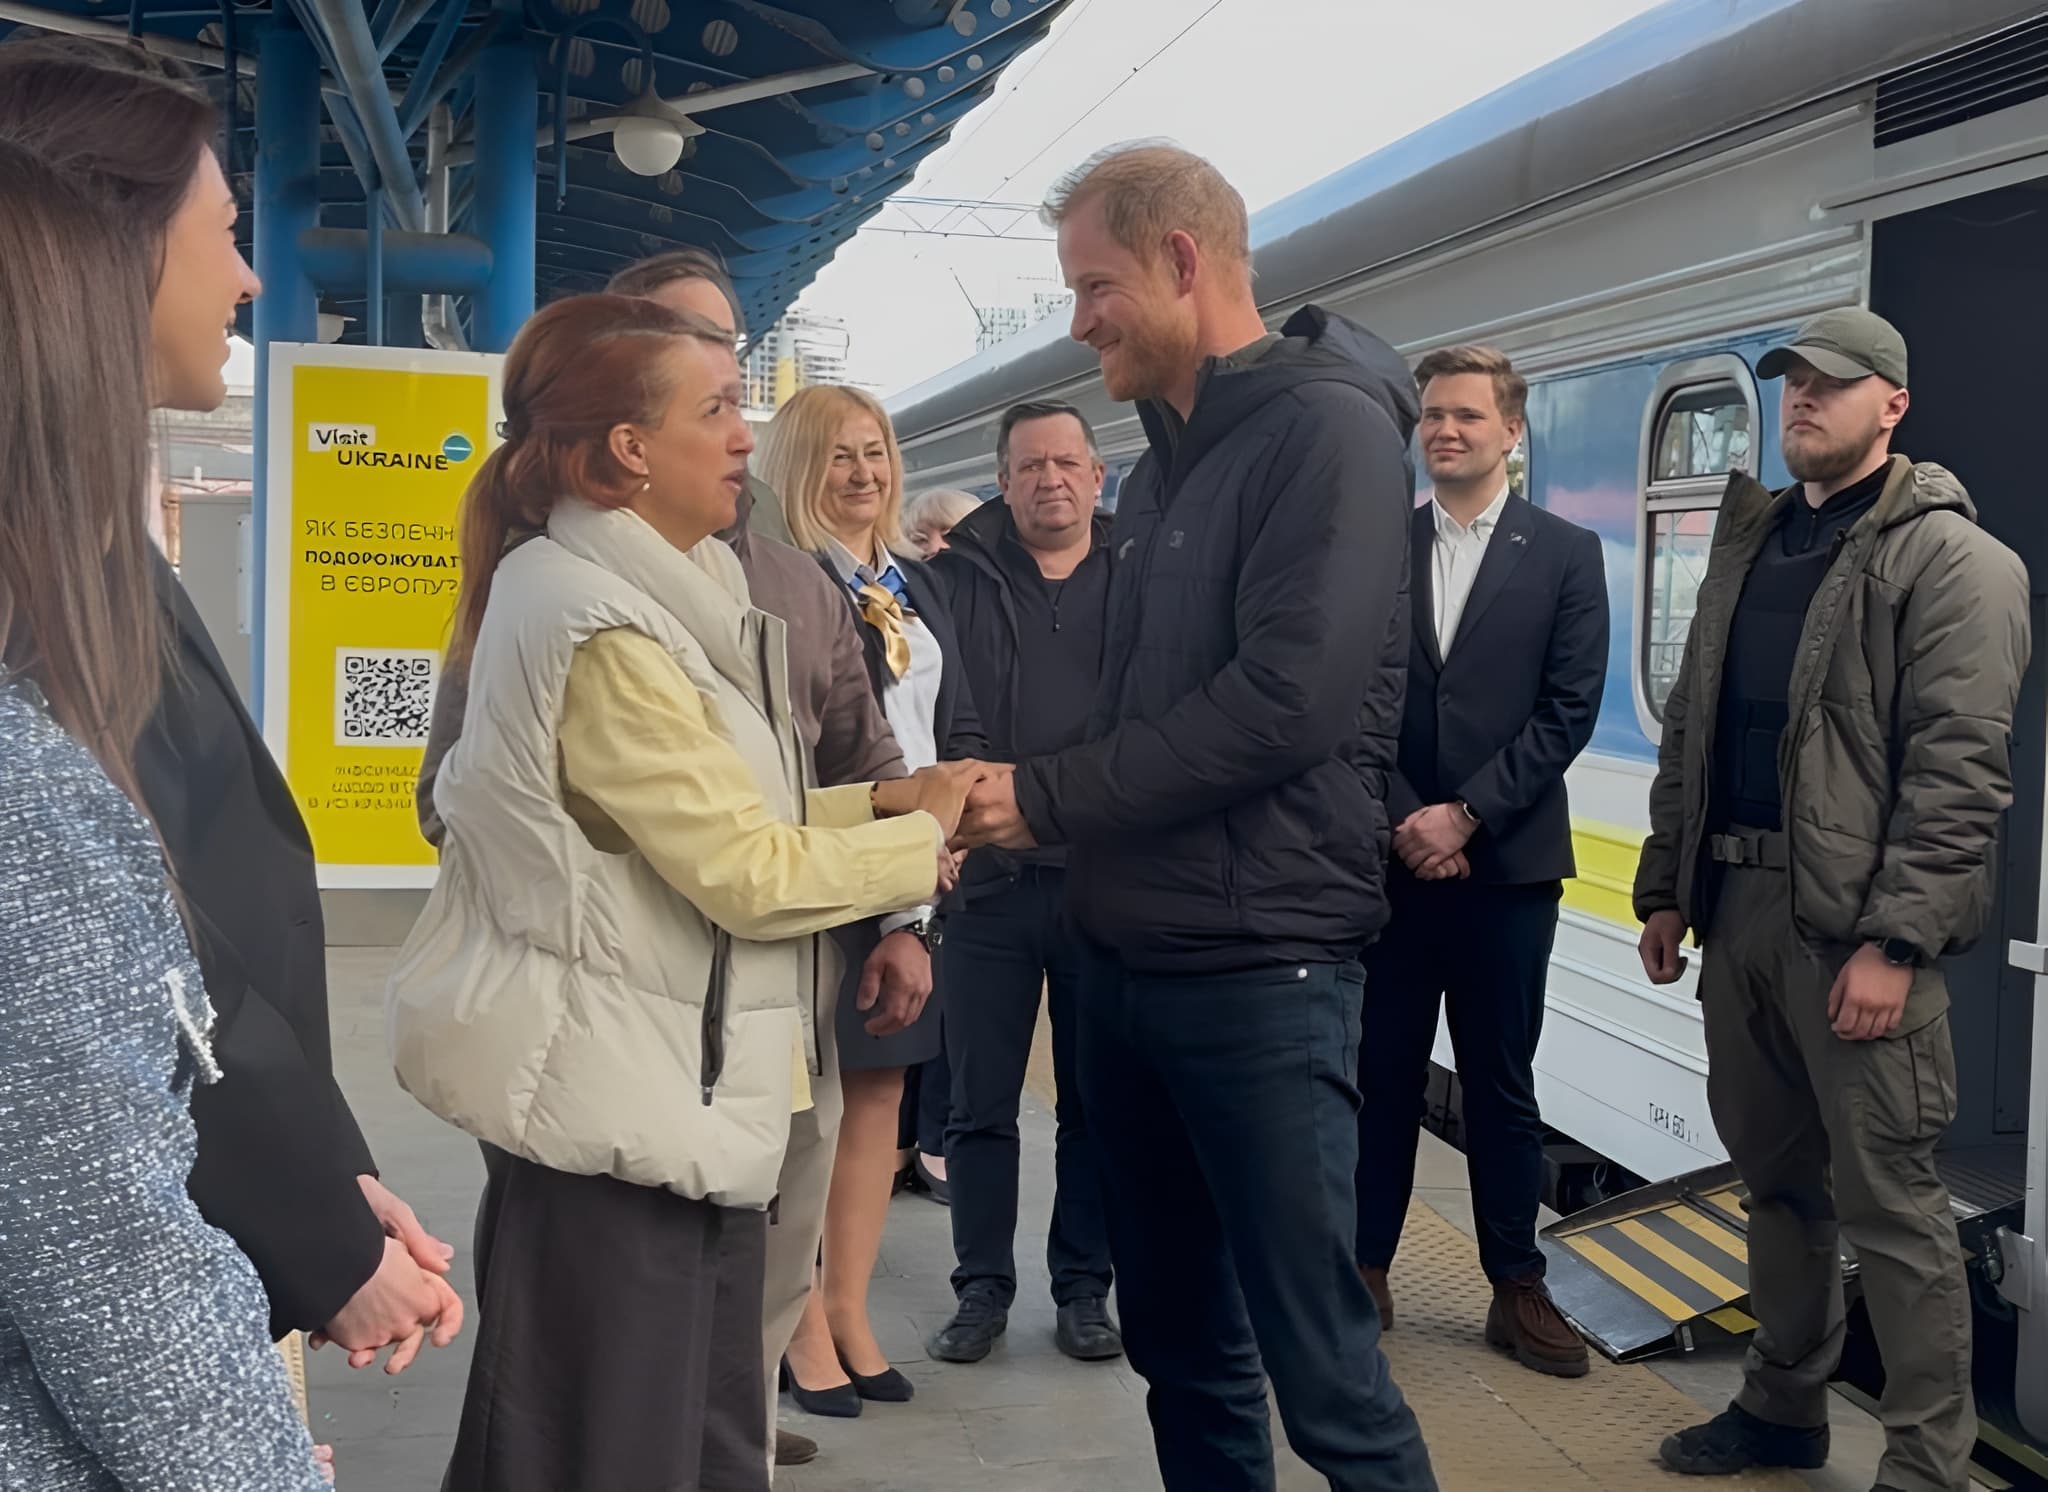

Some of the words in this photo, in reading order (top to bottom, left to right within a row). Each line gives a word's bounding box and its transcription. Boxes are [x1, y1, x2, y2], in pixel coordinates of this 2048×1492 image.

[338, 449, 449, 471] UKRAINE
[305, 519, 337, 537] ЯК
[344, 521, 455, 541] БЕЗПЕЧН
[305, 550, 462, 568] ПОДОРОЖУВАТ
[321, 574, 336, 592] В
